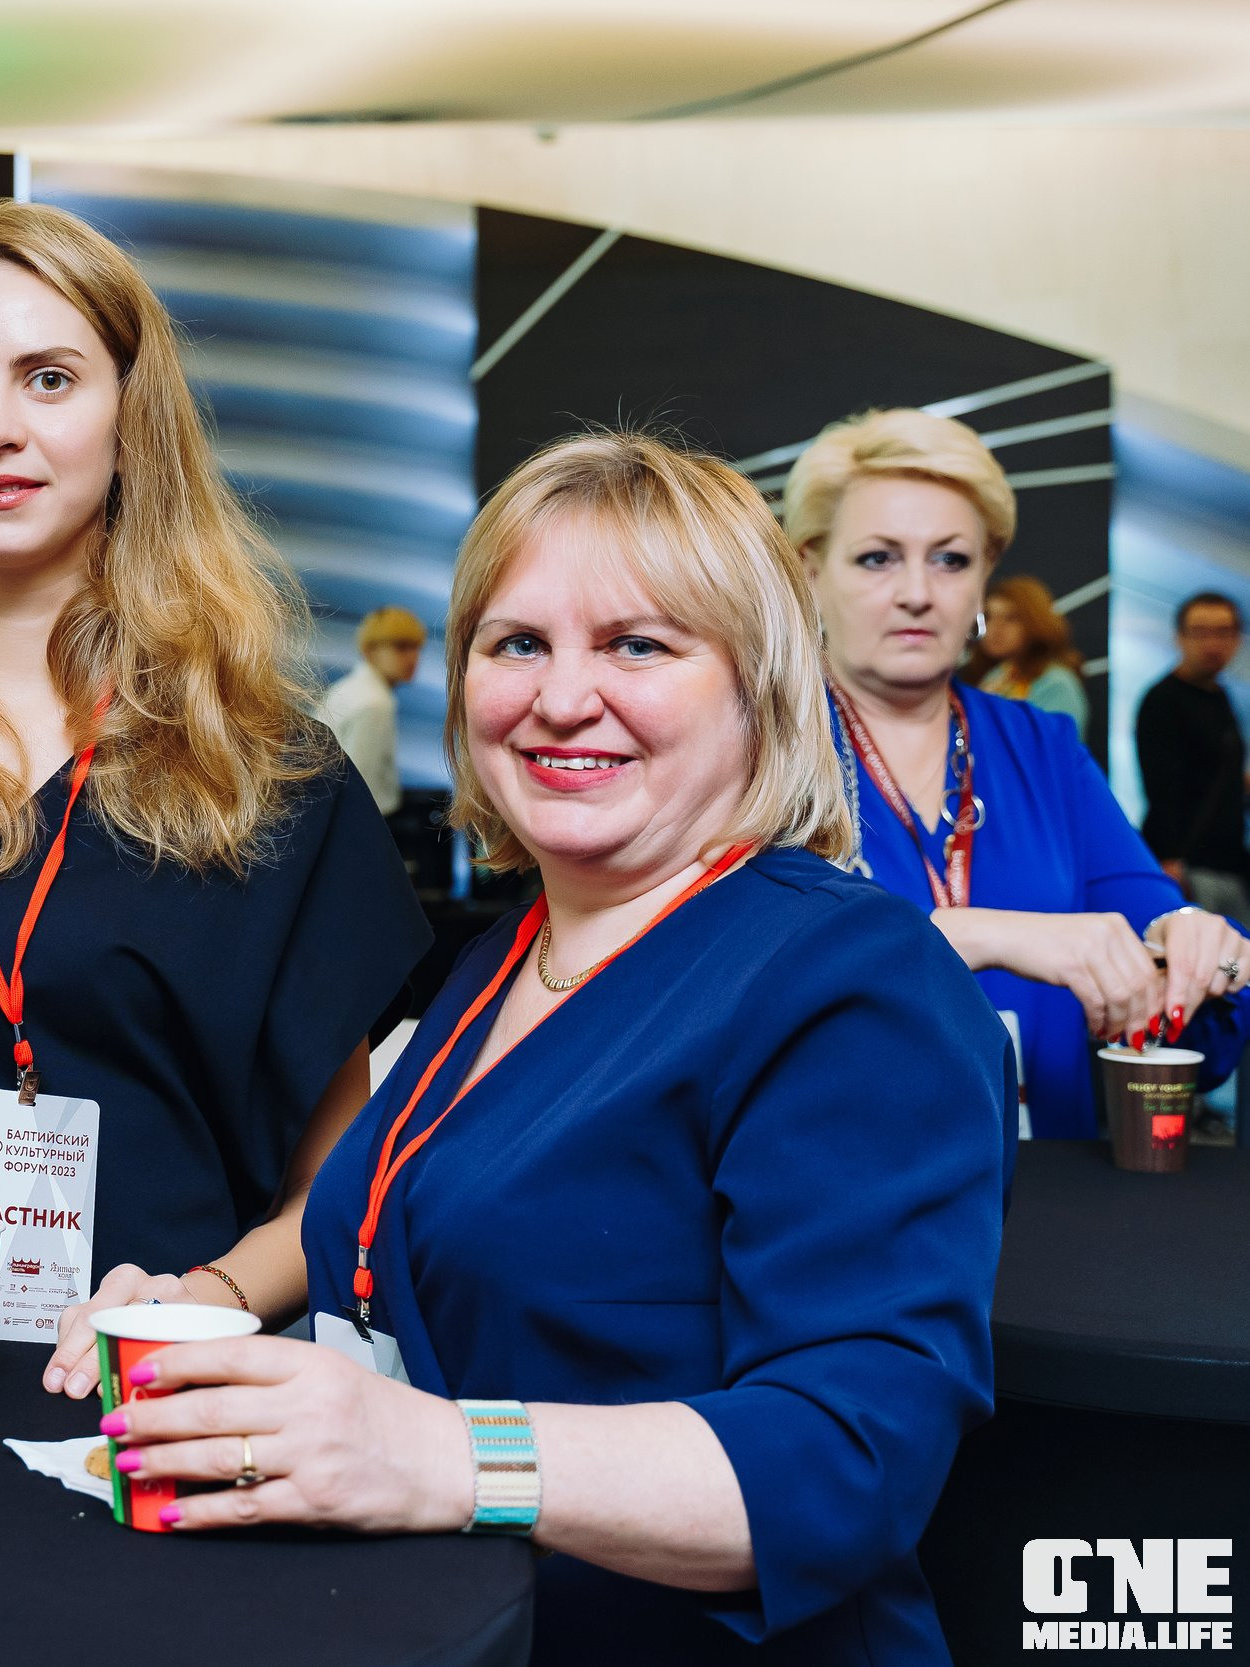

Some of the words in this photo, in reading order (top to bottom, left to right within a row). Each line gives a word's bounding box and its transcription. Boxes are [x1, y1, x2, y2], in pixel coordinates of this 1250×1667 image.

[6, 1128, 89, 1147] БАЛТИЙСКИЙ
[5, 1144, 85, 1163] КУЛЬТУРНЫЙ
[4, 1160, 48, 1174] ФОРУМ
[51, 1165, 76, 1177] 2023
